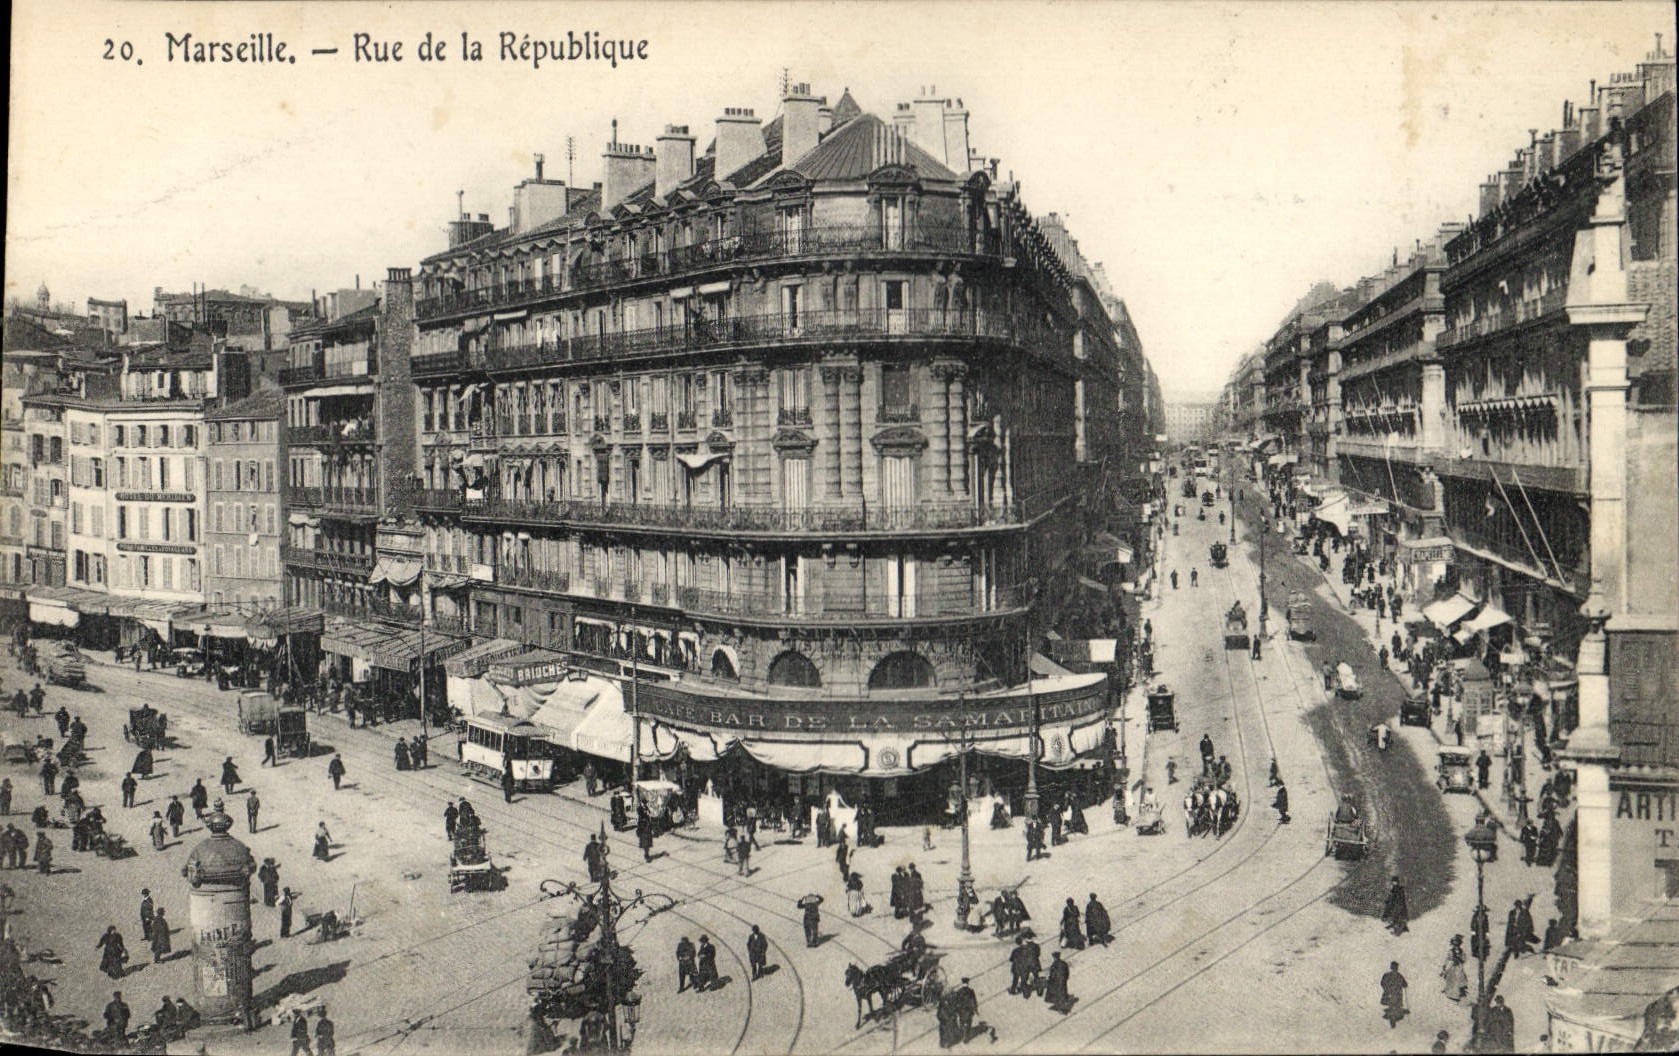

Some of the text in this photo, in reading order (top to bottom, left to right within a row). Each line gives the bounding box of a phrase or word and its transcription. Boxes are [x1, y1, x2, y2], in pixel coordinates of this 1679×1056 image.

[518, 661, 568, 682] BRIOCHES
[711, 711, 766, 728] BAR
[784, 715, 828, 729] DE
[850, 715, 894, 729] LA
